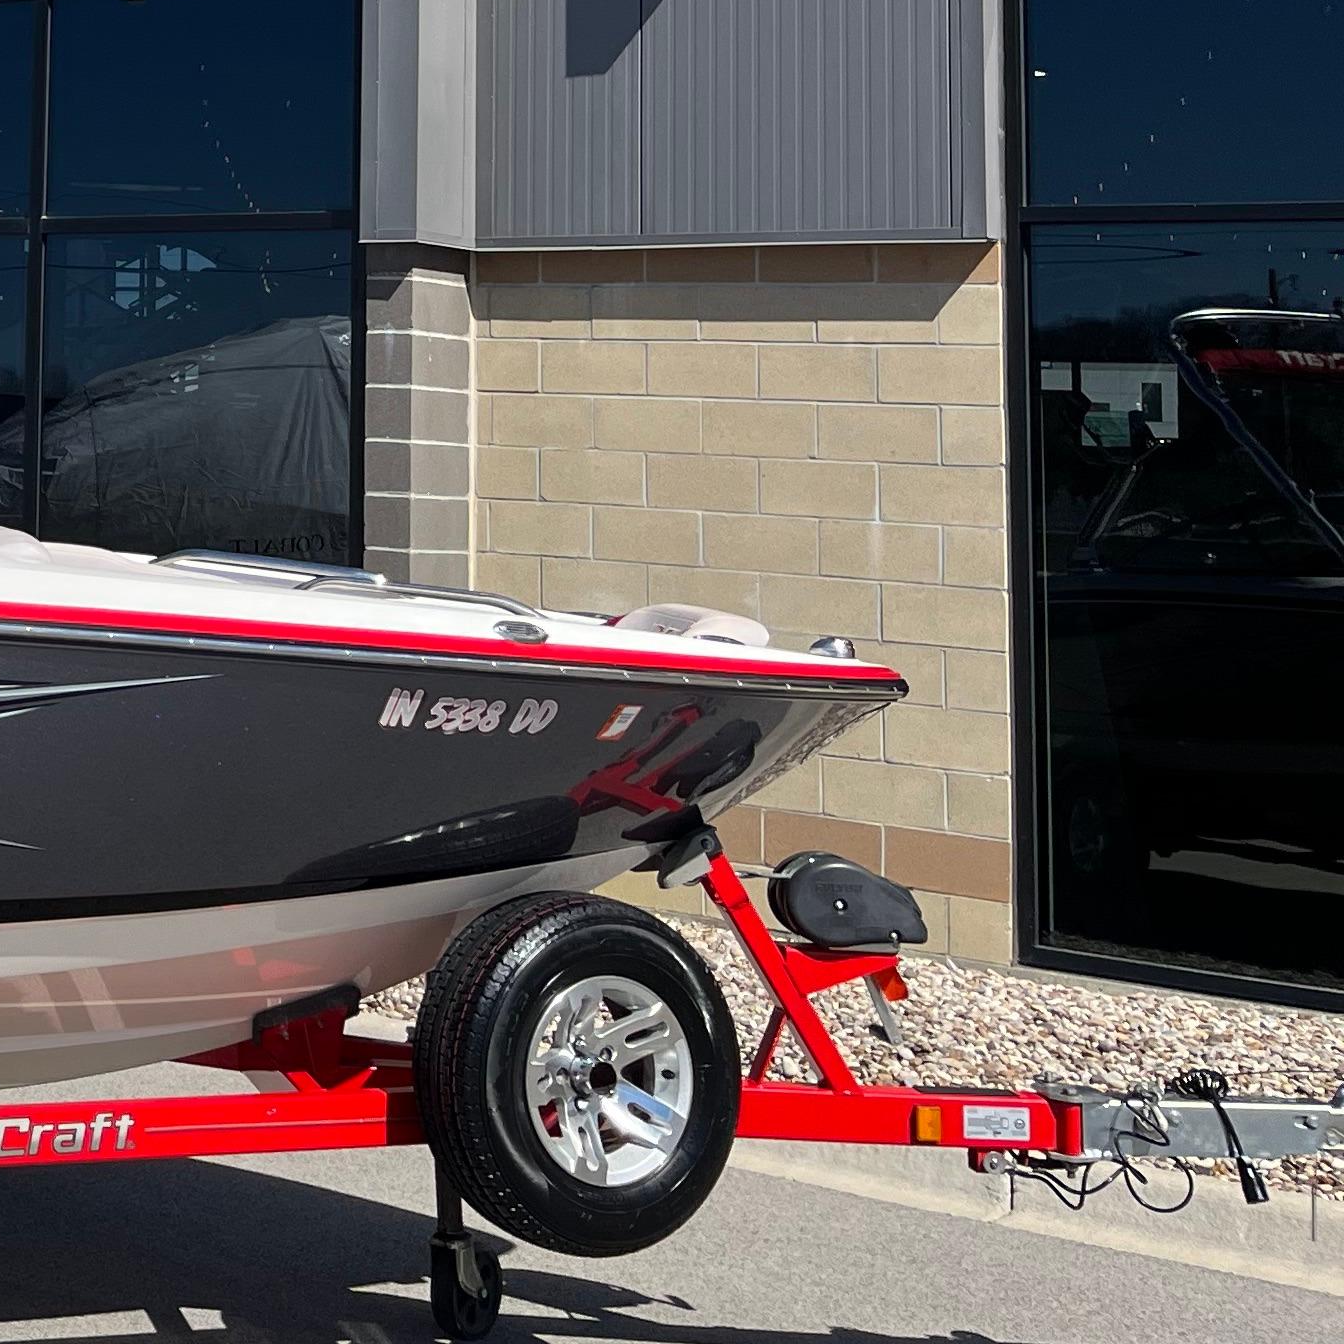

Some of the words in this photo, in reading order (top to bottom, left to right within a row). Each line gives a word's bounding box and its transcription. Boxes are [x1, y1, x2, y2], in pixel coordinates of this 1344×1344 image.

[378, 687, 425, 728] IN
[424, 697, 507, 735] 5338
[508, 698, 559, 735] DD
